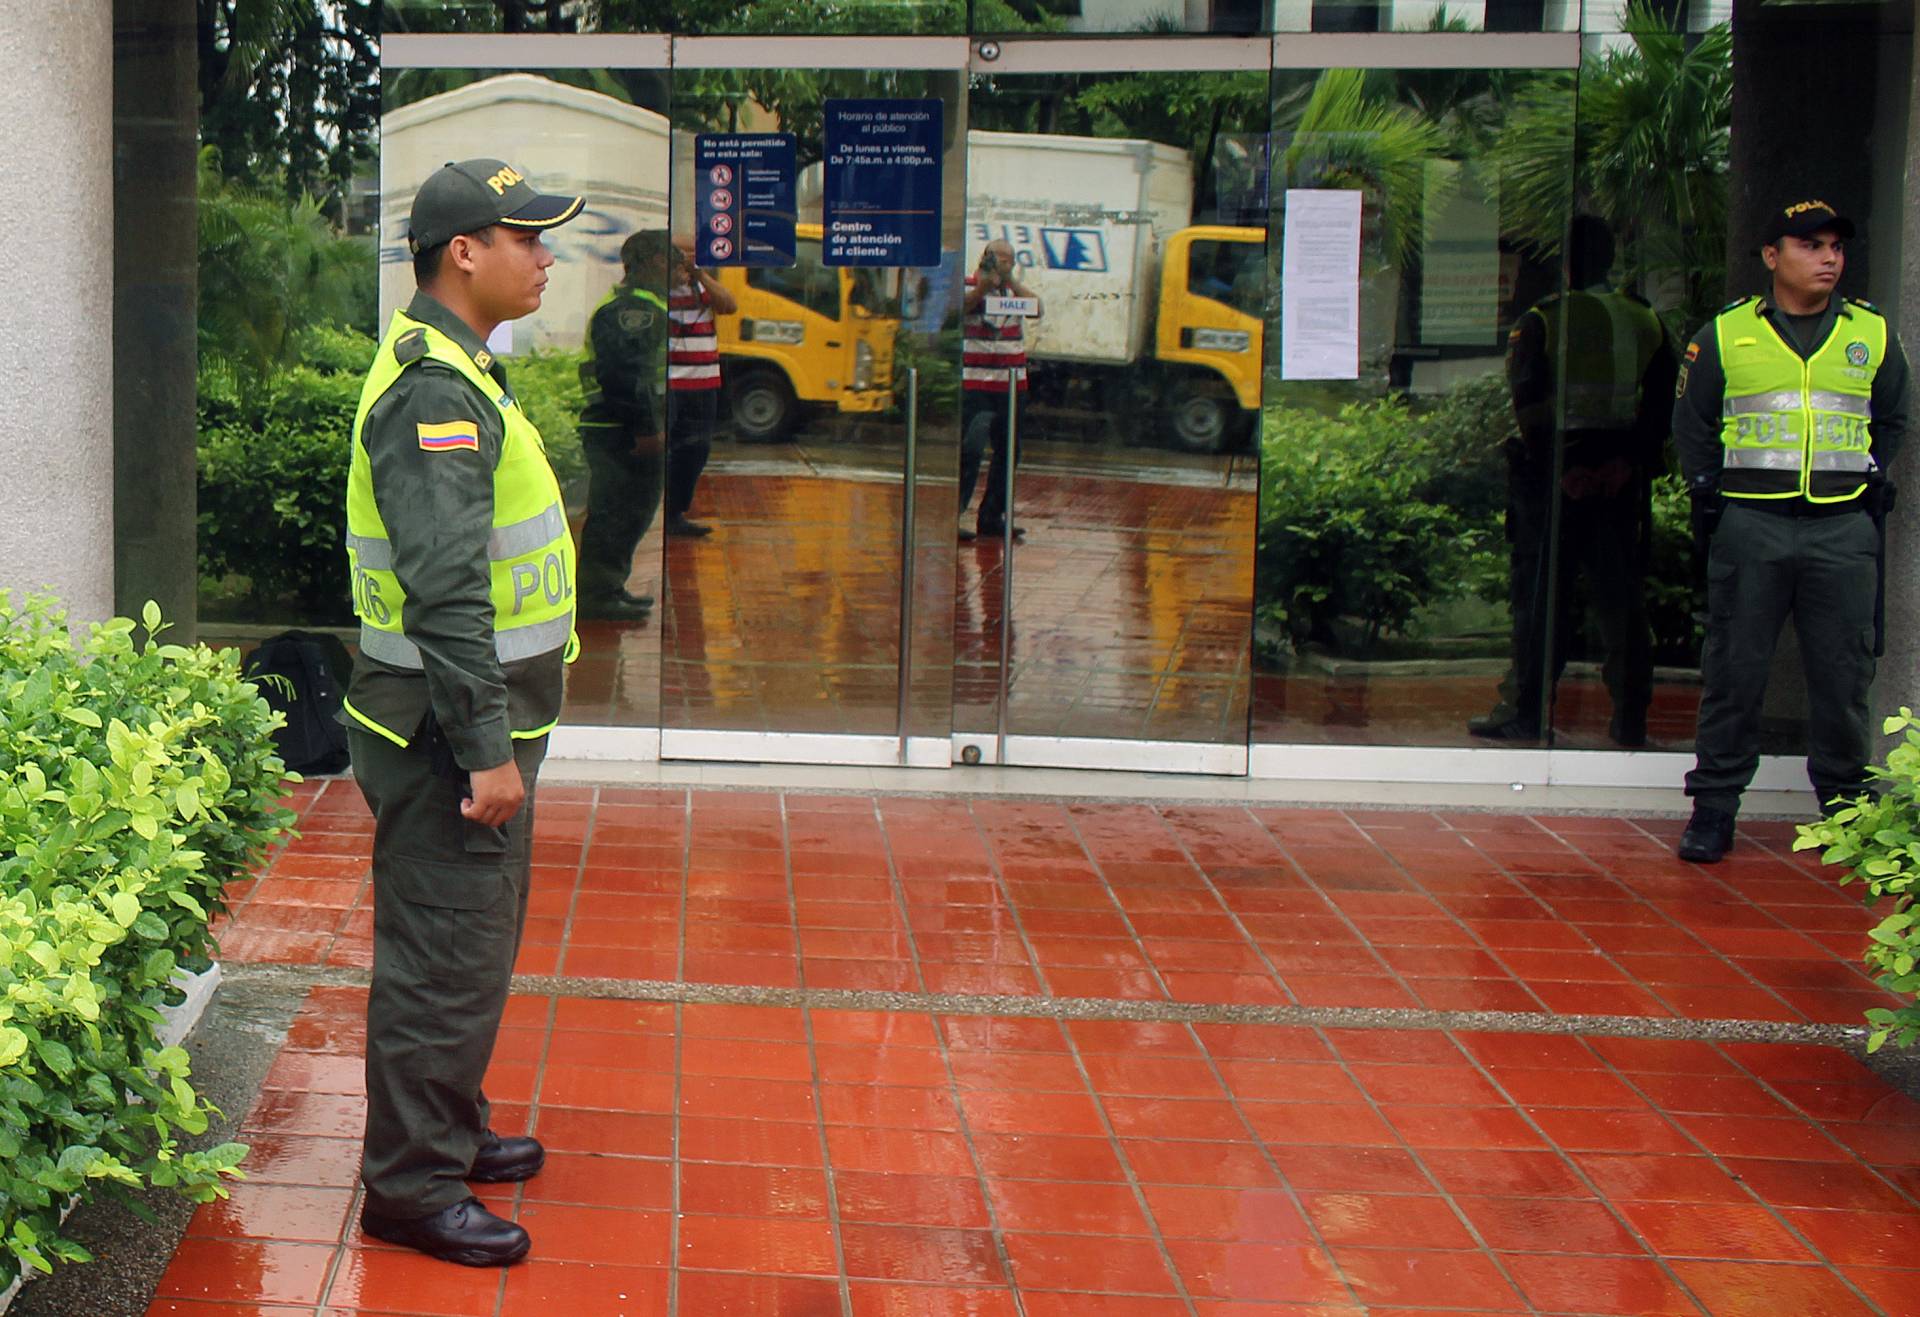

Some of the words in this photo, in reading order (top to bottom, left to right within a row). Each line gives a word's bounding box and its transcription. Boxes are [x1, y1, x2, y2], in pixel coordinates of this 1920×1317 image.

[838, 112, 873, 120] Horario
[875, 112, 888, 120] de
[890, 111, 930, 120] atención
[861, 124, 870, 133] al
[872, 123, 906, 135] público
[703, 139, 717, 148] No
[719, 139, 740, 148] está
[741, 139, 787, 150] permitido
[840, 144, 853, 153] De
[855, 144, 881, 153] lunes
[892, 144, 926, 153] viernes
[741, 150, 763, 158] sala:
[831, 156, 844, 164] De
[832, 221, 873, 231] Centro
[832, 234, 847, 244] de
[849, 233, 902, 244] atención
[832, 246, 843, 256] al
[846, 246, 888, 256] cliente
[1000, 300, 1027, 310] HALE
